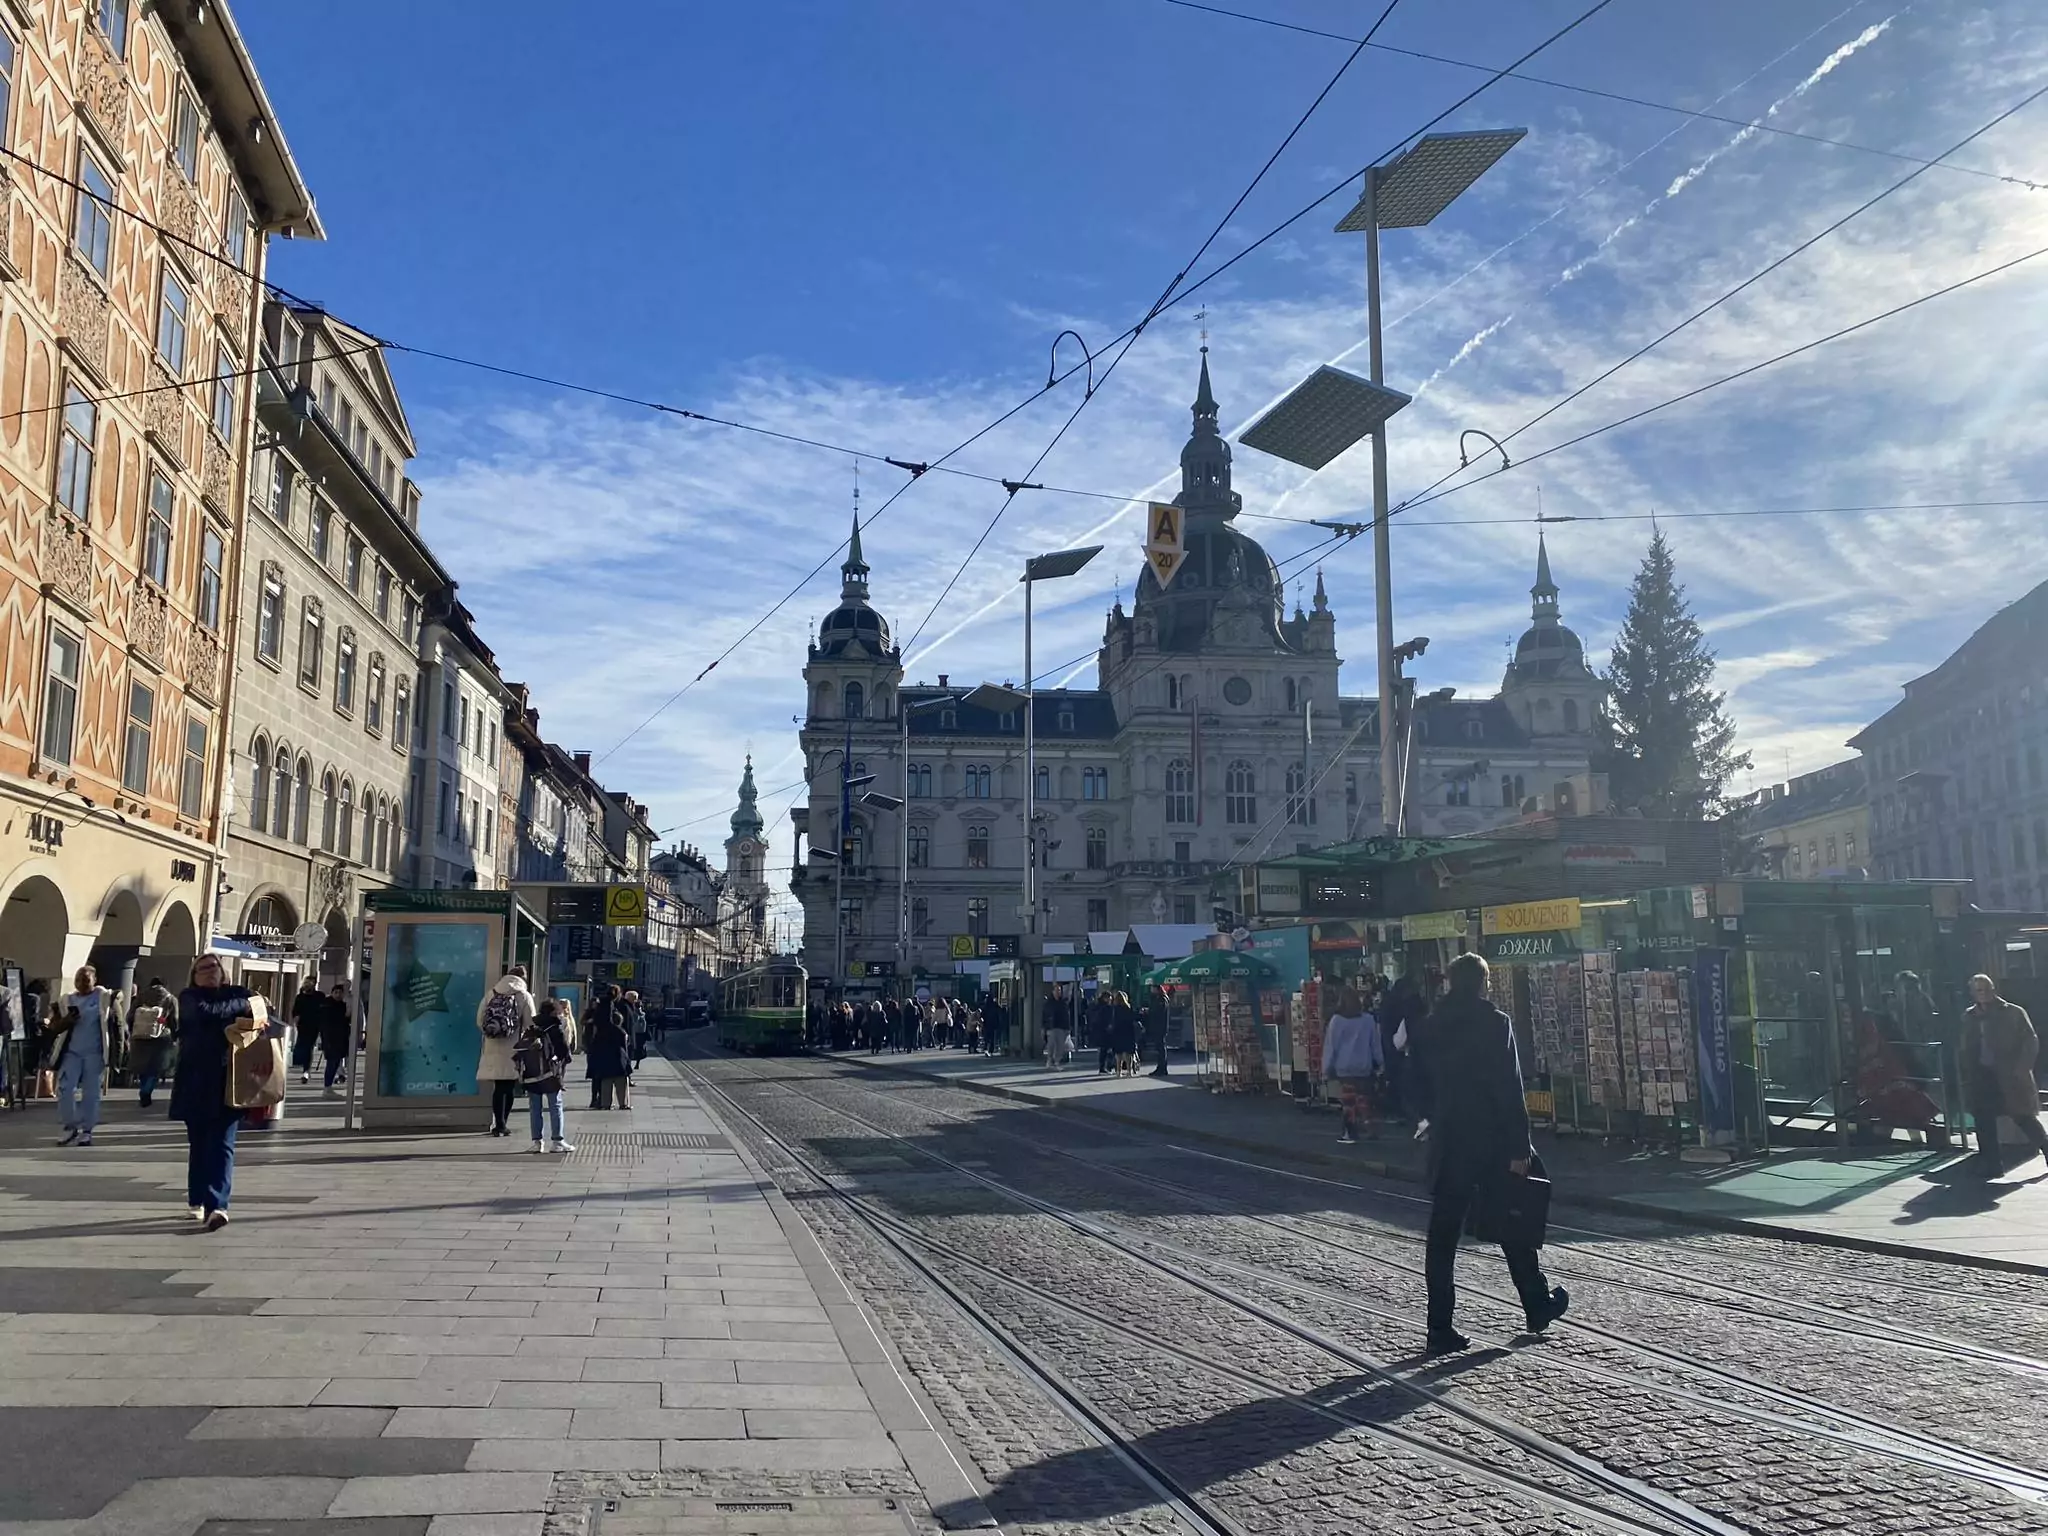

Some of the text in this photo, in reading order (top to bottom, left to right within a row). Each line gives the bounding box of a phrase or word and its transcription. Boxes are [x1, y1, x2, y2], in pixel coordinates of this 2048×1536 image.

[1155, 510, 1177, 542] A
[1157, 552, 1172, 568] 20
[1504, 903, 1571, 928] SOUVENIR
